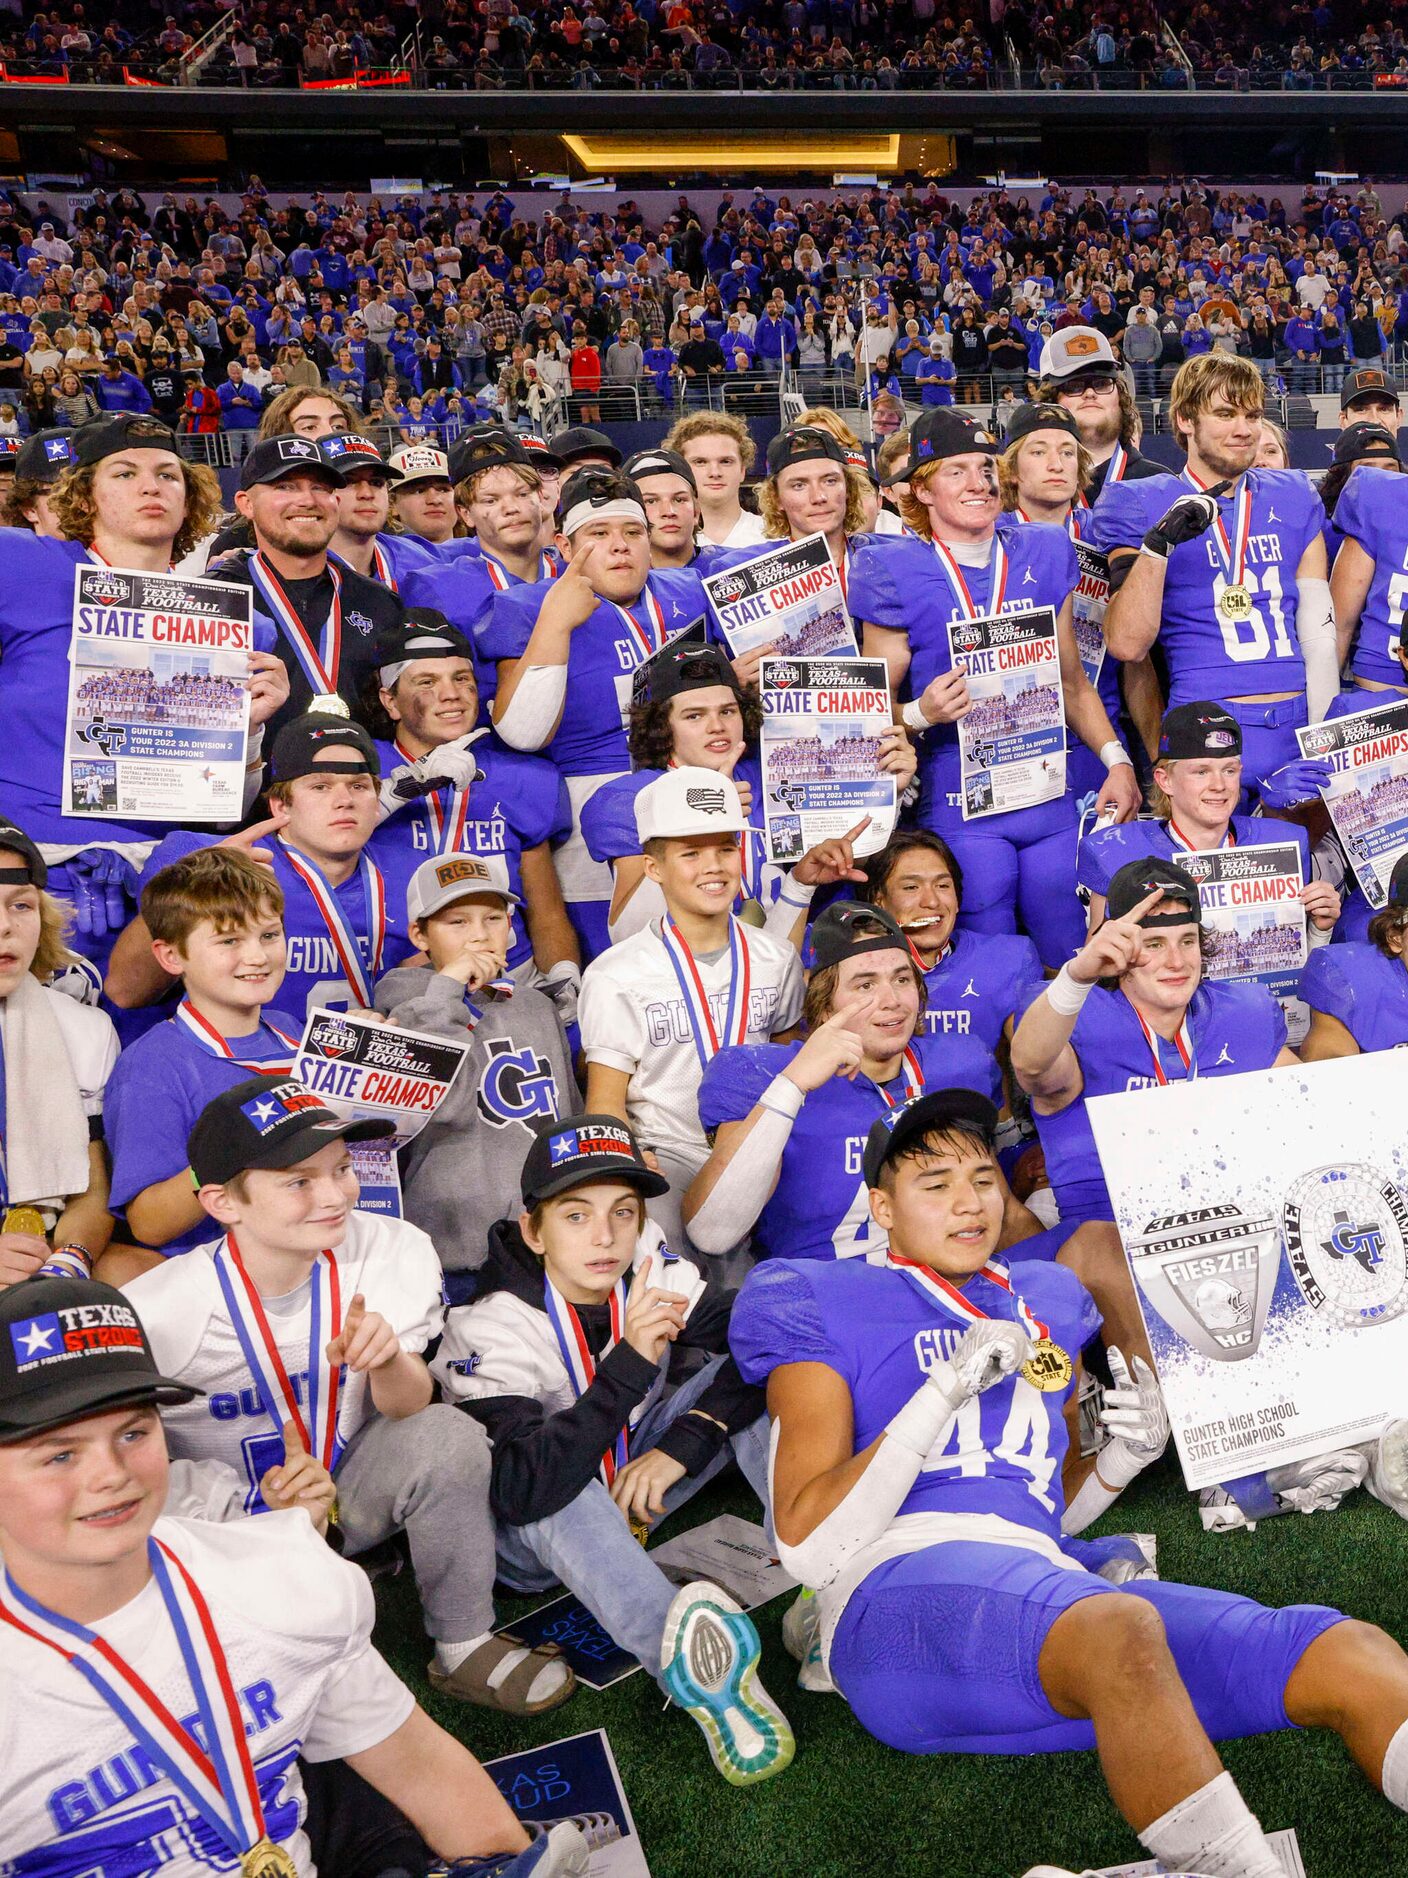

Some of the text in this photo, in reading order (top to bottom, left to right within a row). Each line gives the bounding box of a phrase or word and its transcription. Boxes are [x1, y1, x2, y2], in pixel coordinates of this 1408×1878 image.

[752, 562, 783, 580] TEXAS
[756, 560, 810, 588] FOOTBALL
[85, 583, 128, 597] STATE
[142, 588, 186, 599] TEXAS
[713, 581, 745, 598] STATE
[720, 564, 836, 630] STATE CHAMPS!
[141, 596, 220, 613] FOOTBALL
[1212, 565, 1295, 662] 61
[78, 607, 249, 649] STATE CHAMPS!
[988, 626, 1015, 636] TEXAS
[990, 629, 1036, 644] FOOTBALL
[954, 634, 980, 644] STATE
[998, 639, 1056, 670] CHAMPS!
[766, 671, 798, 679] STATE
[808, 677, 866, 685] FOOTBALL
[764, 692, 889, 713] STATE CHAMPS!
[131, 727, 174, 737] GUNTER IS
[1342, 723, 1371, 737] TEXAS
[1343, 724, 1393, 744] FOOTBALL
[131, 737, 152, 746] YOUR
[155, 739, 176, 748] 2022
[178, 740, 190, 748] 3A
[192, 741, 226, 750] DIVISION
[998, 739, 1016, 747] GUNTER
[1034, 739, 1053, 747] DIVISION
[130, 746, 204, 758] STATE CHAMPIONS
[1014, 749, 1042, 760] CHAMPIONS
[1220, 860, 1251, 869] TEXAS
[1221, 864, 1277, 877] FOOTBALL
[1231, 876, 1300, 905] CHAMPS!
[312, 1030, 356, 1050] STATE
[416, 1040, 446, 1051] CHAMPIONSHIP
[368, 1040, 408, 1058] TEXAS
[363, 1051, 431, 1074] FOOTBALL
[300, 1057, 447, 1112] STATE CHAMPS!
[576, 1125, 631, 1146] TEXAS
[578, 1138, 634, 1157] STRONG
[360, 1200, 392, 1209] DIVISION 2
[1148, 1228, 1244, 1254] GUNTER
[1283, 1203, 1326, 1308] STATE
[58, 1304, 136, 1331] TEXAS
[64, 1326, 144, 1352] STRONG
[41, 1350, 83, 1366] FOOTBALL
[1041, 1372, 1061, 1381] STATE
[1183, 1421, 1226, 1445] GUNTER
[1228, 1413, 1256, 1432] HIGH
[1257, 1401, 1300, 1425] SCHOOL
[1188, 1441, 1220, 1462] STATE
[1221, 1422, 1286, 1453] CHAMPIONS
